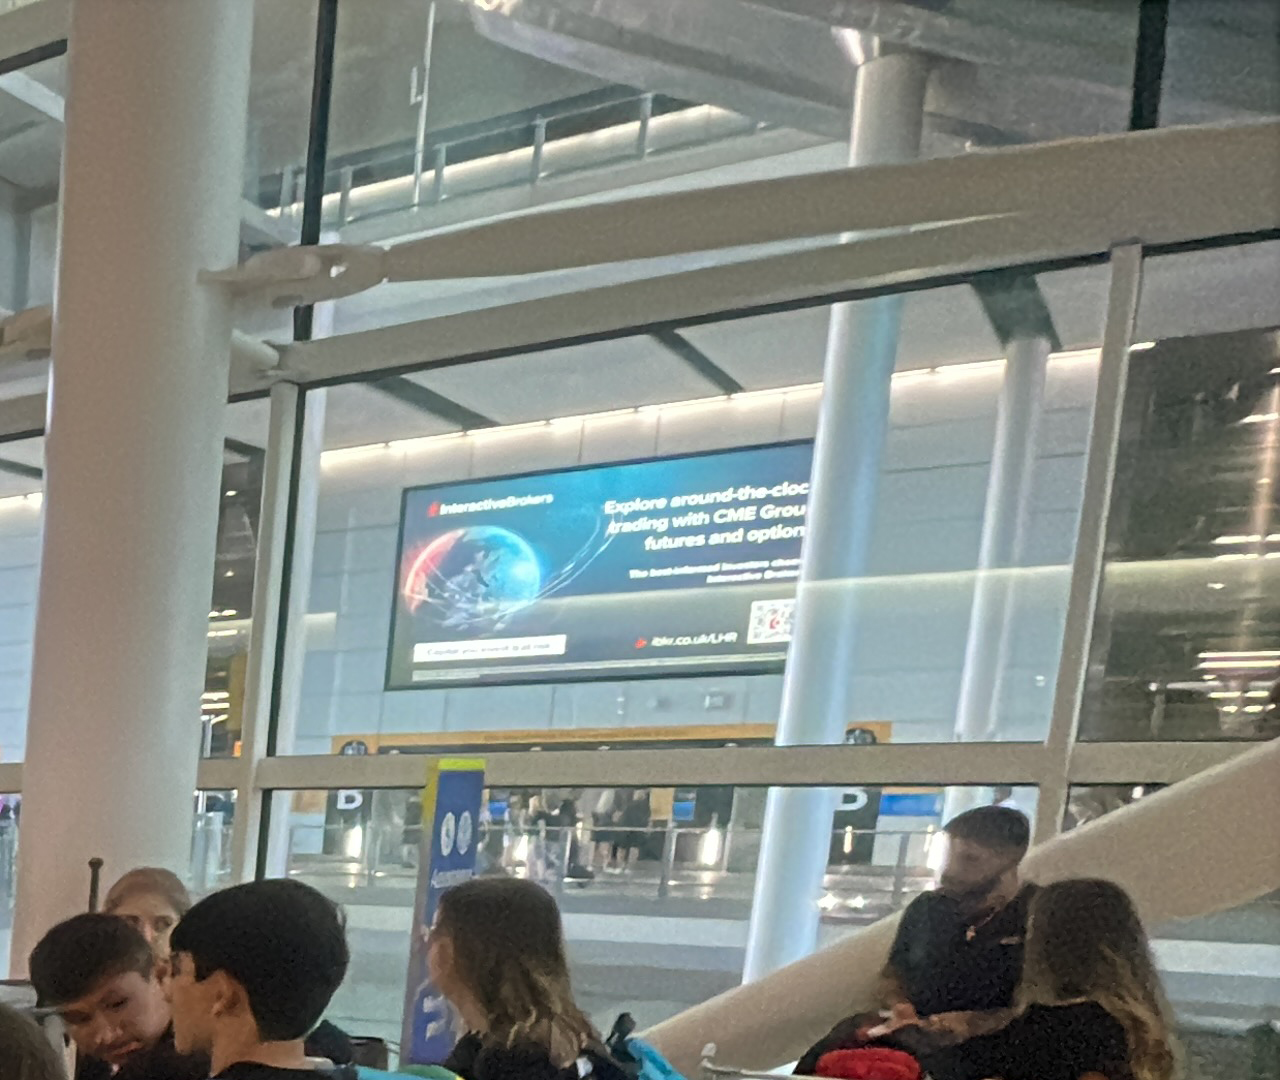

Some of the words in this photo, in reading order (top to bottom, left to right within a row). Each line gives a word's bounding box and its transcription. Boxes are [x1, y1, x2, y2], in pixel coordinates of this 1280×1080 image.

[604, 497, 668, 516] Explore
[670, 481, 810, 508] around-the-cloc
[606, 516, 669, 536] trading
[672, 511, 710, 528] with
[713, 506, 757, 524] CME
[760, 503, 807, 520] Grou
[644, 533, 706, 551] futures
[708, 528, 744, 545] and
[746, 523, 805, 544] option
